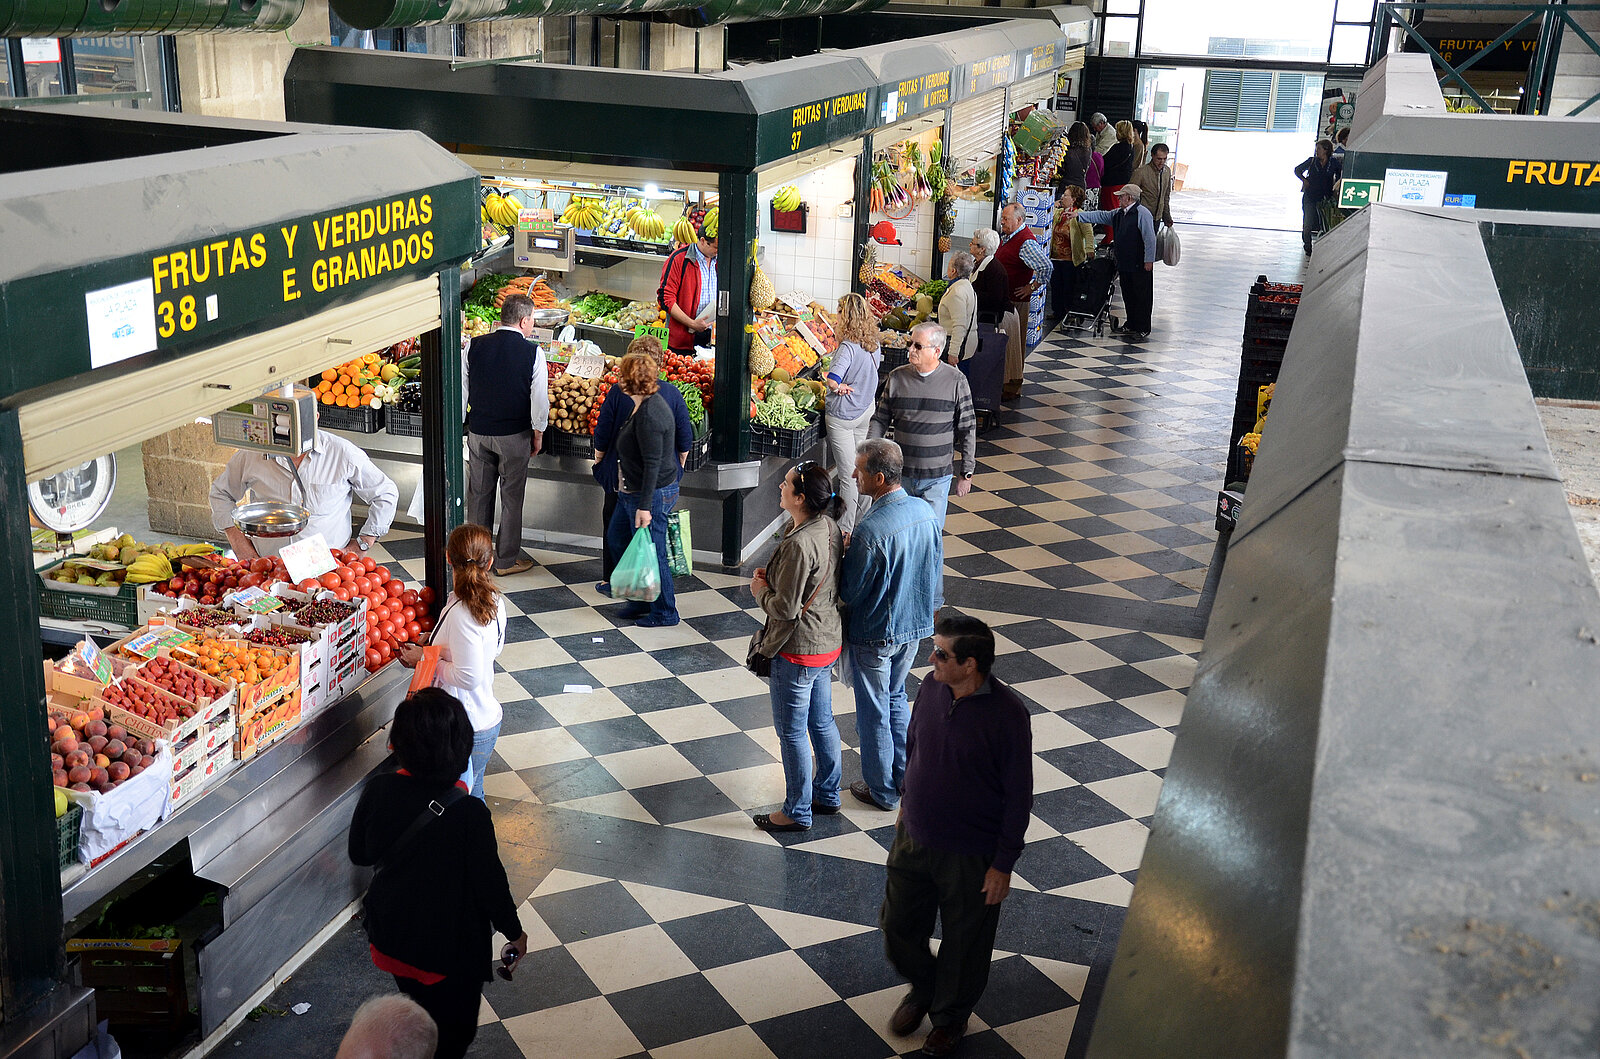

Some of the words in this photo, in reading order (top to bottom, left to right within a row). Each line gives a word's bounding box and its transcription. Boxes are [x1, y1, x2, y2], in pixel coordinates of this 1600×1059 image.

[1503, 41, 1513, 50] Y
[971, 61, 987, 77] FRUTAS
[987, 60, 991, 72] Y
[991, 55, 1011, 71] VERDURAS
[898, 78, 919, 97] FRUTAS
[920, 77, 924, 91] Y
[925, 70, 950, 89] VERDURAS
[929, 88, 949, 107] ORTEGA
[792, 103, 822, 128] FRUTAS
[824, 101, 830, 118] Y
[832, 92, 866, 116] VERDURAS
[791, 130, 802, 151] 37
[1409, 179, 1430, 187] PLAZA
[152, 232, 267, 294] FRUTAS
[281, 225, 299, 259] Y
[312, 194, 433, 252] VERDURAS
[282, 268, 302, 302] E.
[311, 231, 434, 293] GRANADOS
[158, 295, 198, 338] 38
